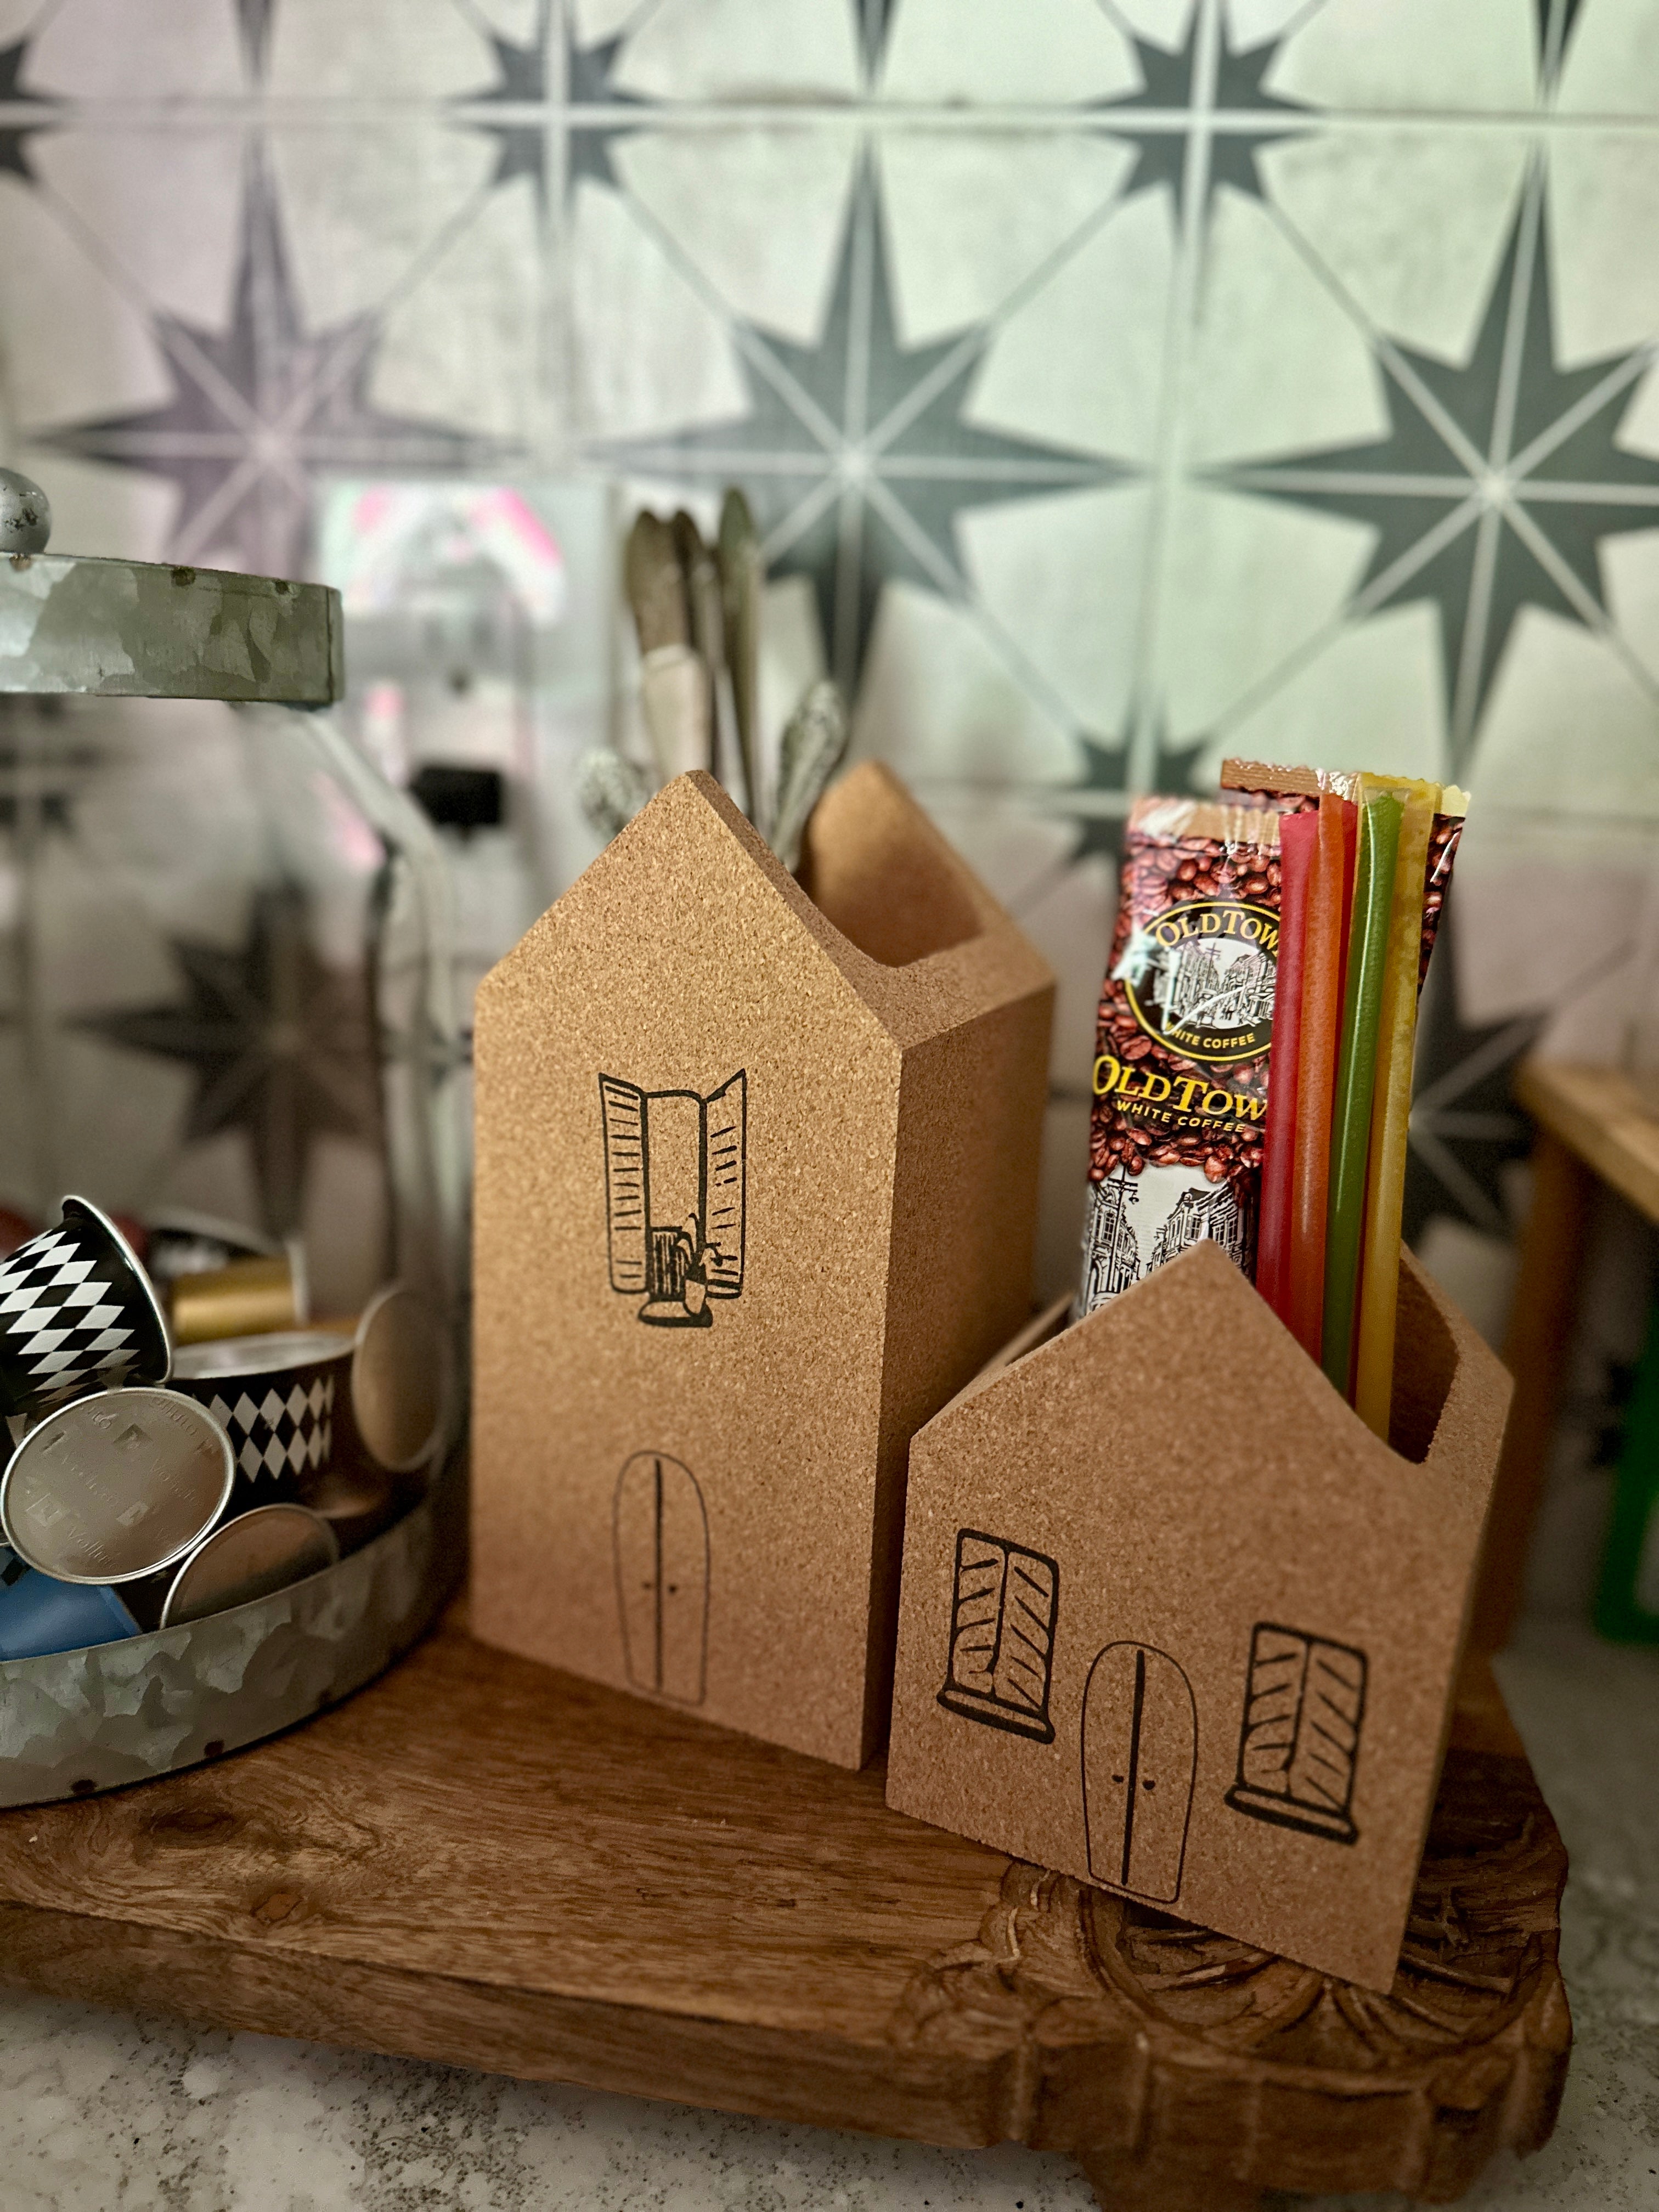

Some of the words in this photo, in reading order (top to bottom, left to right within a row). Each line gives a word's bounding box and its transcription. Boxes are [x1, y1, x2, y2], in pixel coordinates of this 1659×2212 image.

[1155, 910, 1280, 957] OLDTOW
[1203, 1032, 1255, 1049] COFFEE
[1093, 1054, 1268, 1121] OLDTOW
[1116, 1100, 1172, 1123] WHITE
[1177, 1116, 1246, 1133] COFFEE
